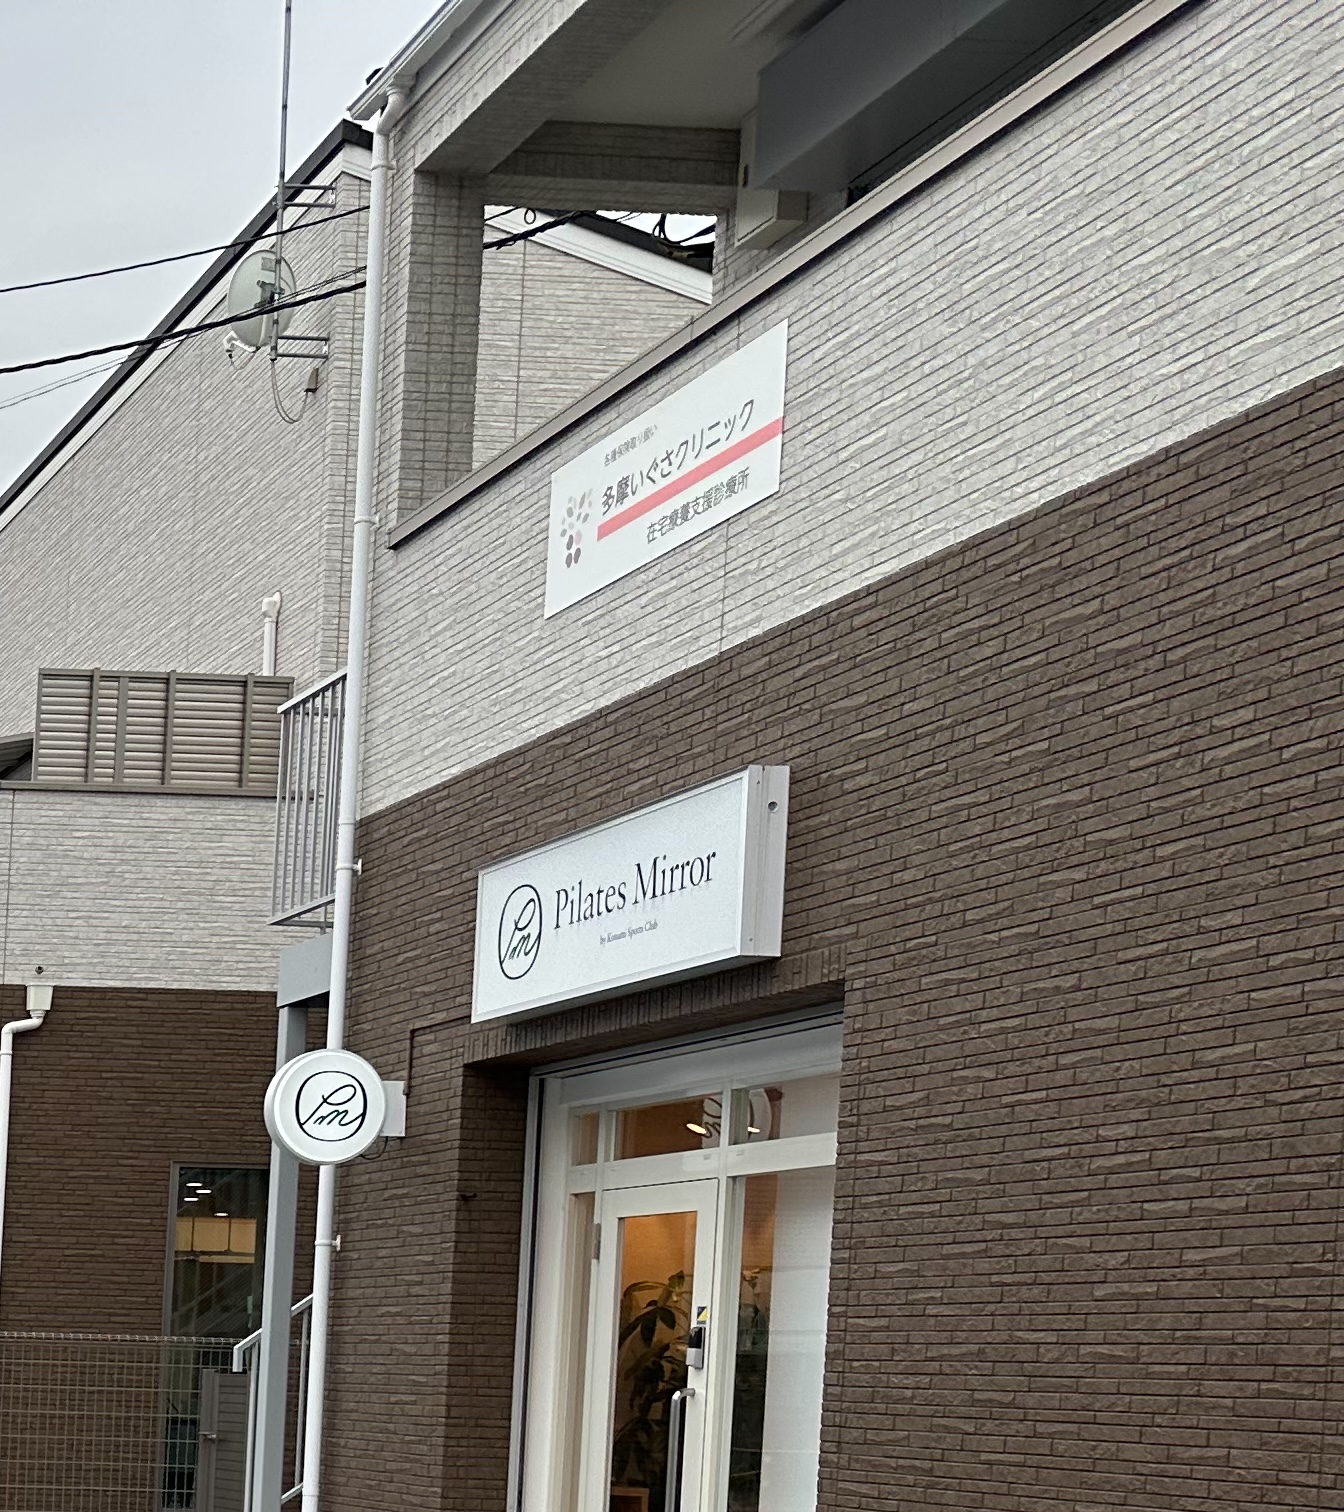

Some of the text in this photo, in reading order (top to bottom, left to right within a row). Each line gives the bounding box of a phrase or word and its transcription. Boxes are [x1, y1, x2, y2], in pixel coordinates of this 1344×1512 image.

[601, 399, 755, 516] 多摩いぐさクリニック
[553, 849, 717, 930] Pilates Mirror
